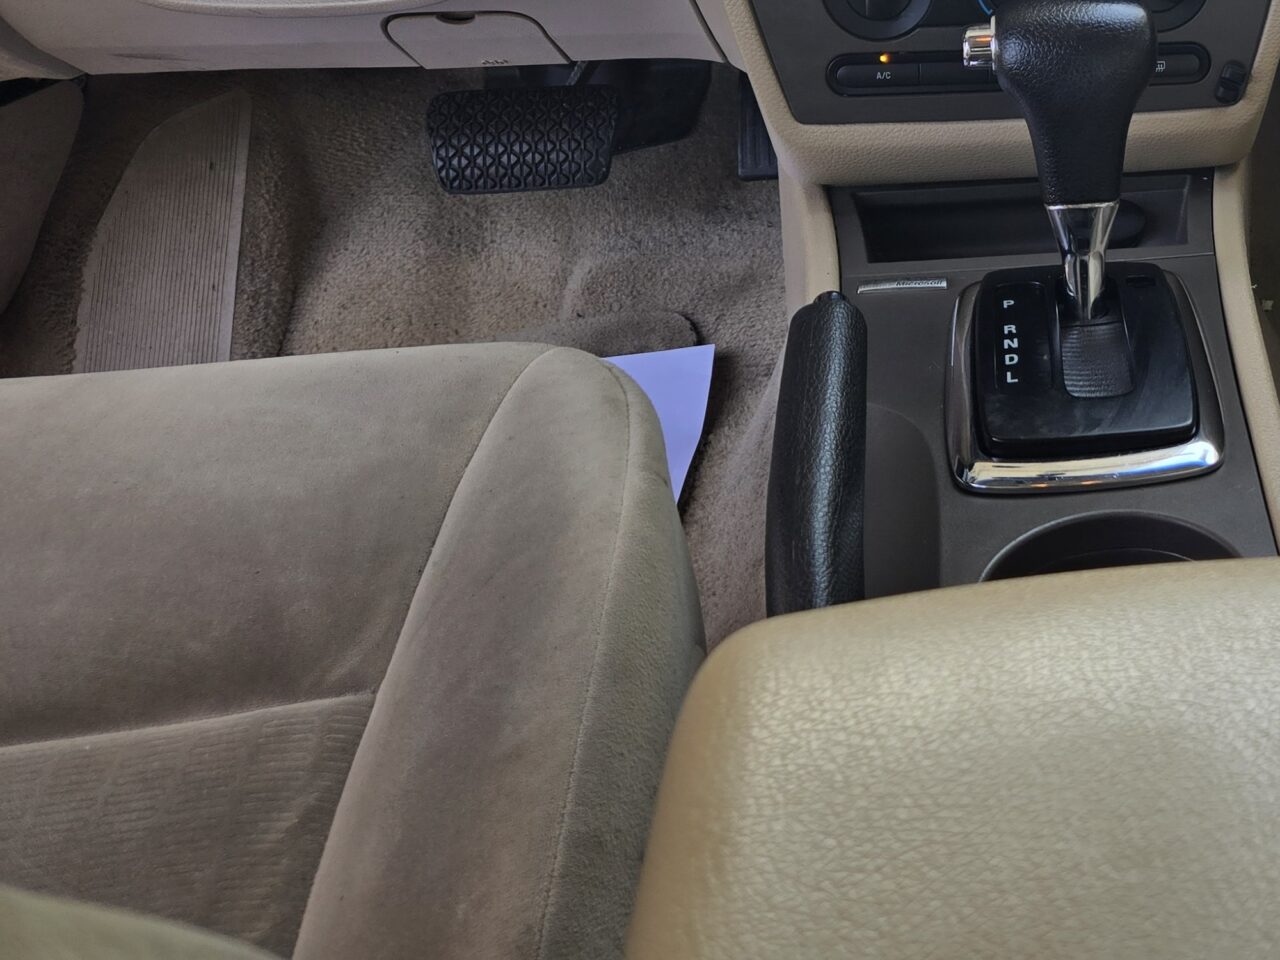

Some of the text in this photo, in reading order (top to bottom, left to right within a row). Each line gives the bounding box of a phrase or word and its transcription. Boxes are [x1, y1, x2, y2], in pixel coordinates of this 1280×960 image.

[876, 71, 891, 80] A/C
[1003, 300, 1015, 308] P
[1003, 324, 1017, 334] R
[1003, 338, 1019, 349] N
[1004, 354, 1019, 365] D
[1006, 371, 1019, 383] L
